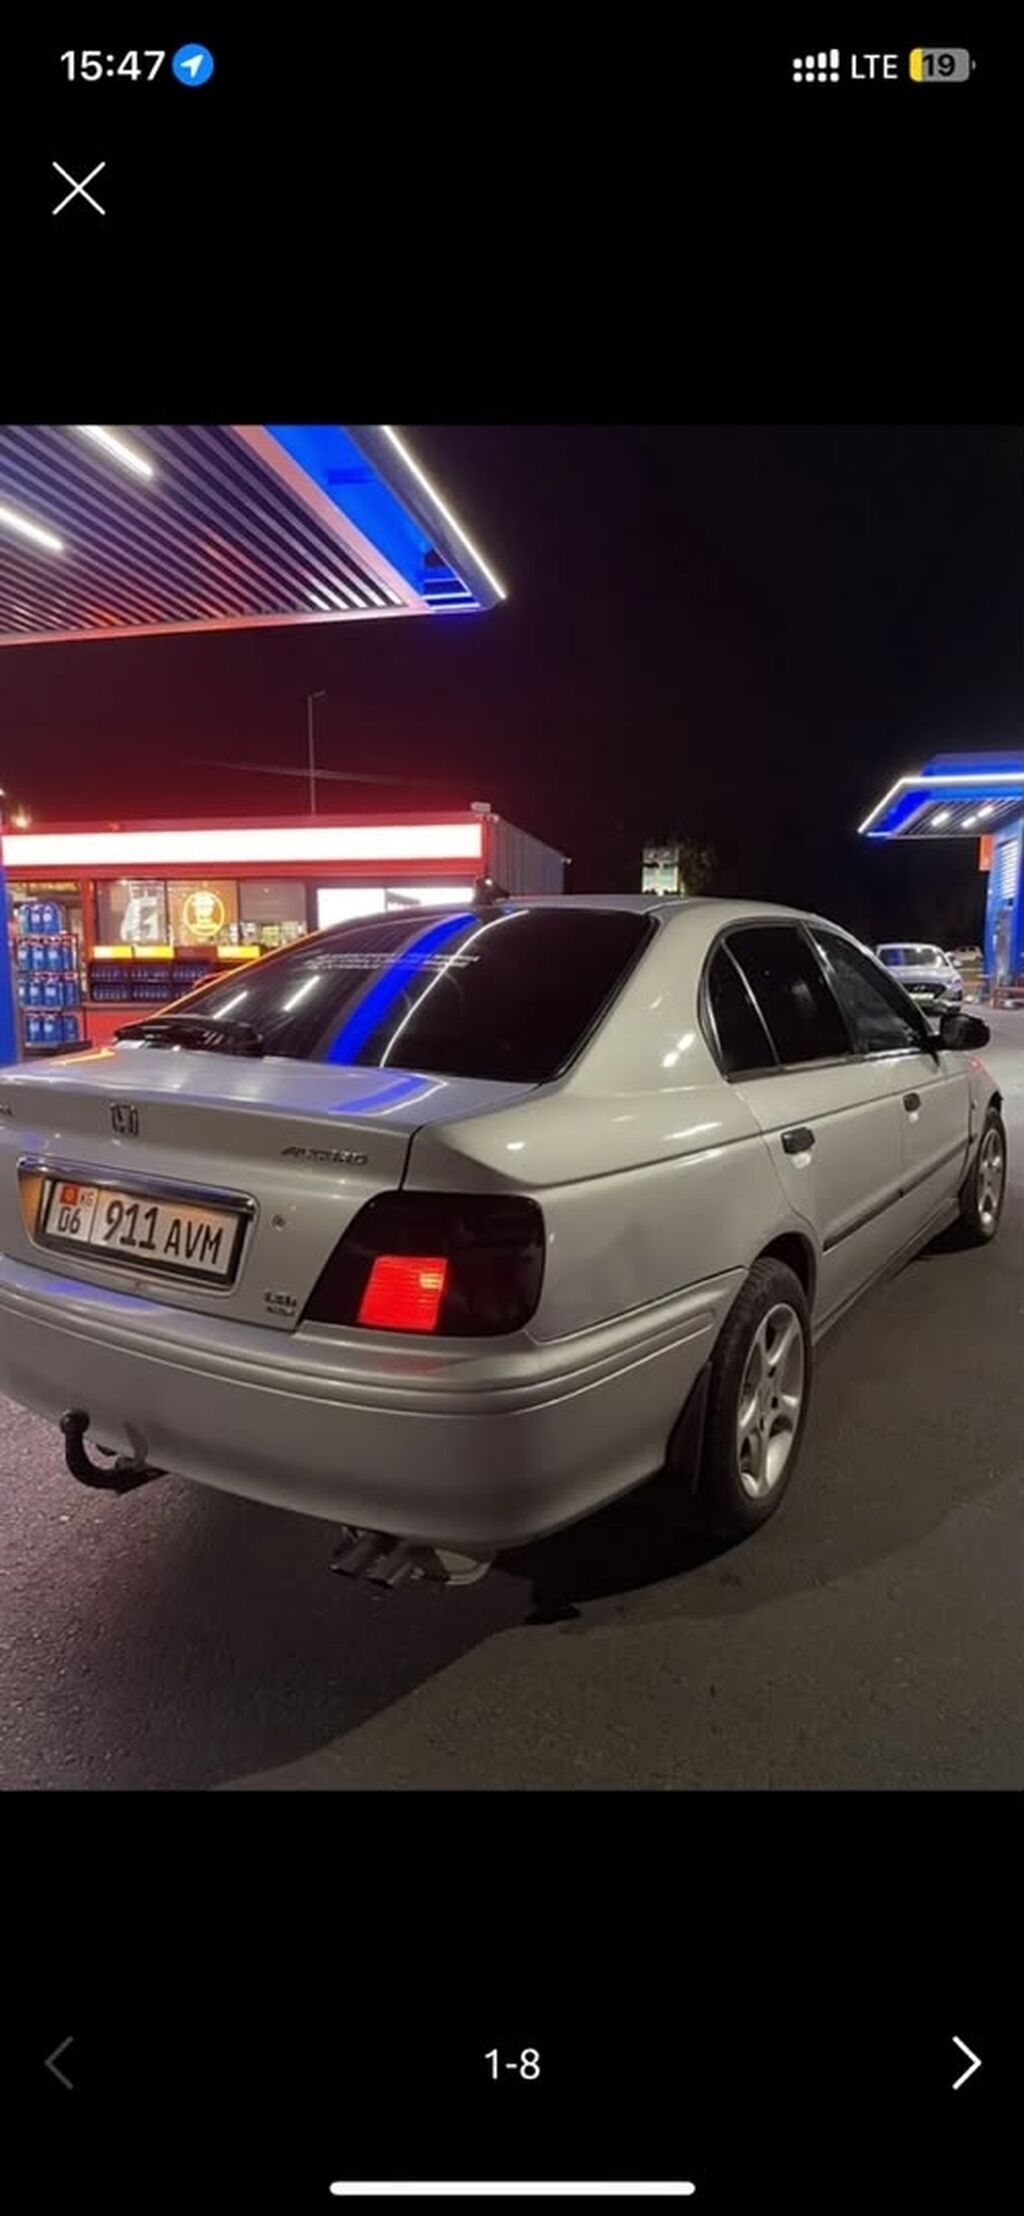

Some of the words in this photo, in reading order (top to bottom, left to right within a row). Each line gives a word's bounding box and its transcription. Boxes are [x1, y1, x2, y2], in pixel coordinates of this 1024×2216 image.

[57, 1206, 82, 1235] 06
[103, 1199, 160, 1251] 911
[163, 1218, 224, 1265] AVM
